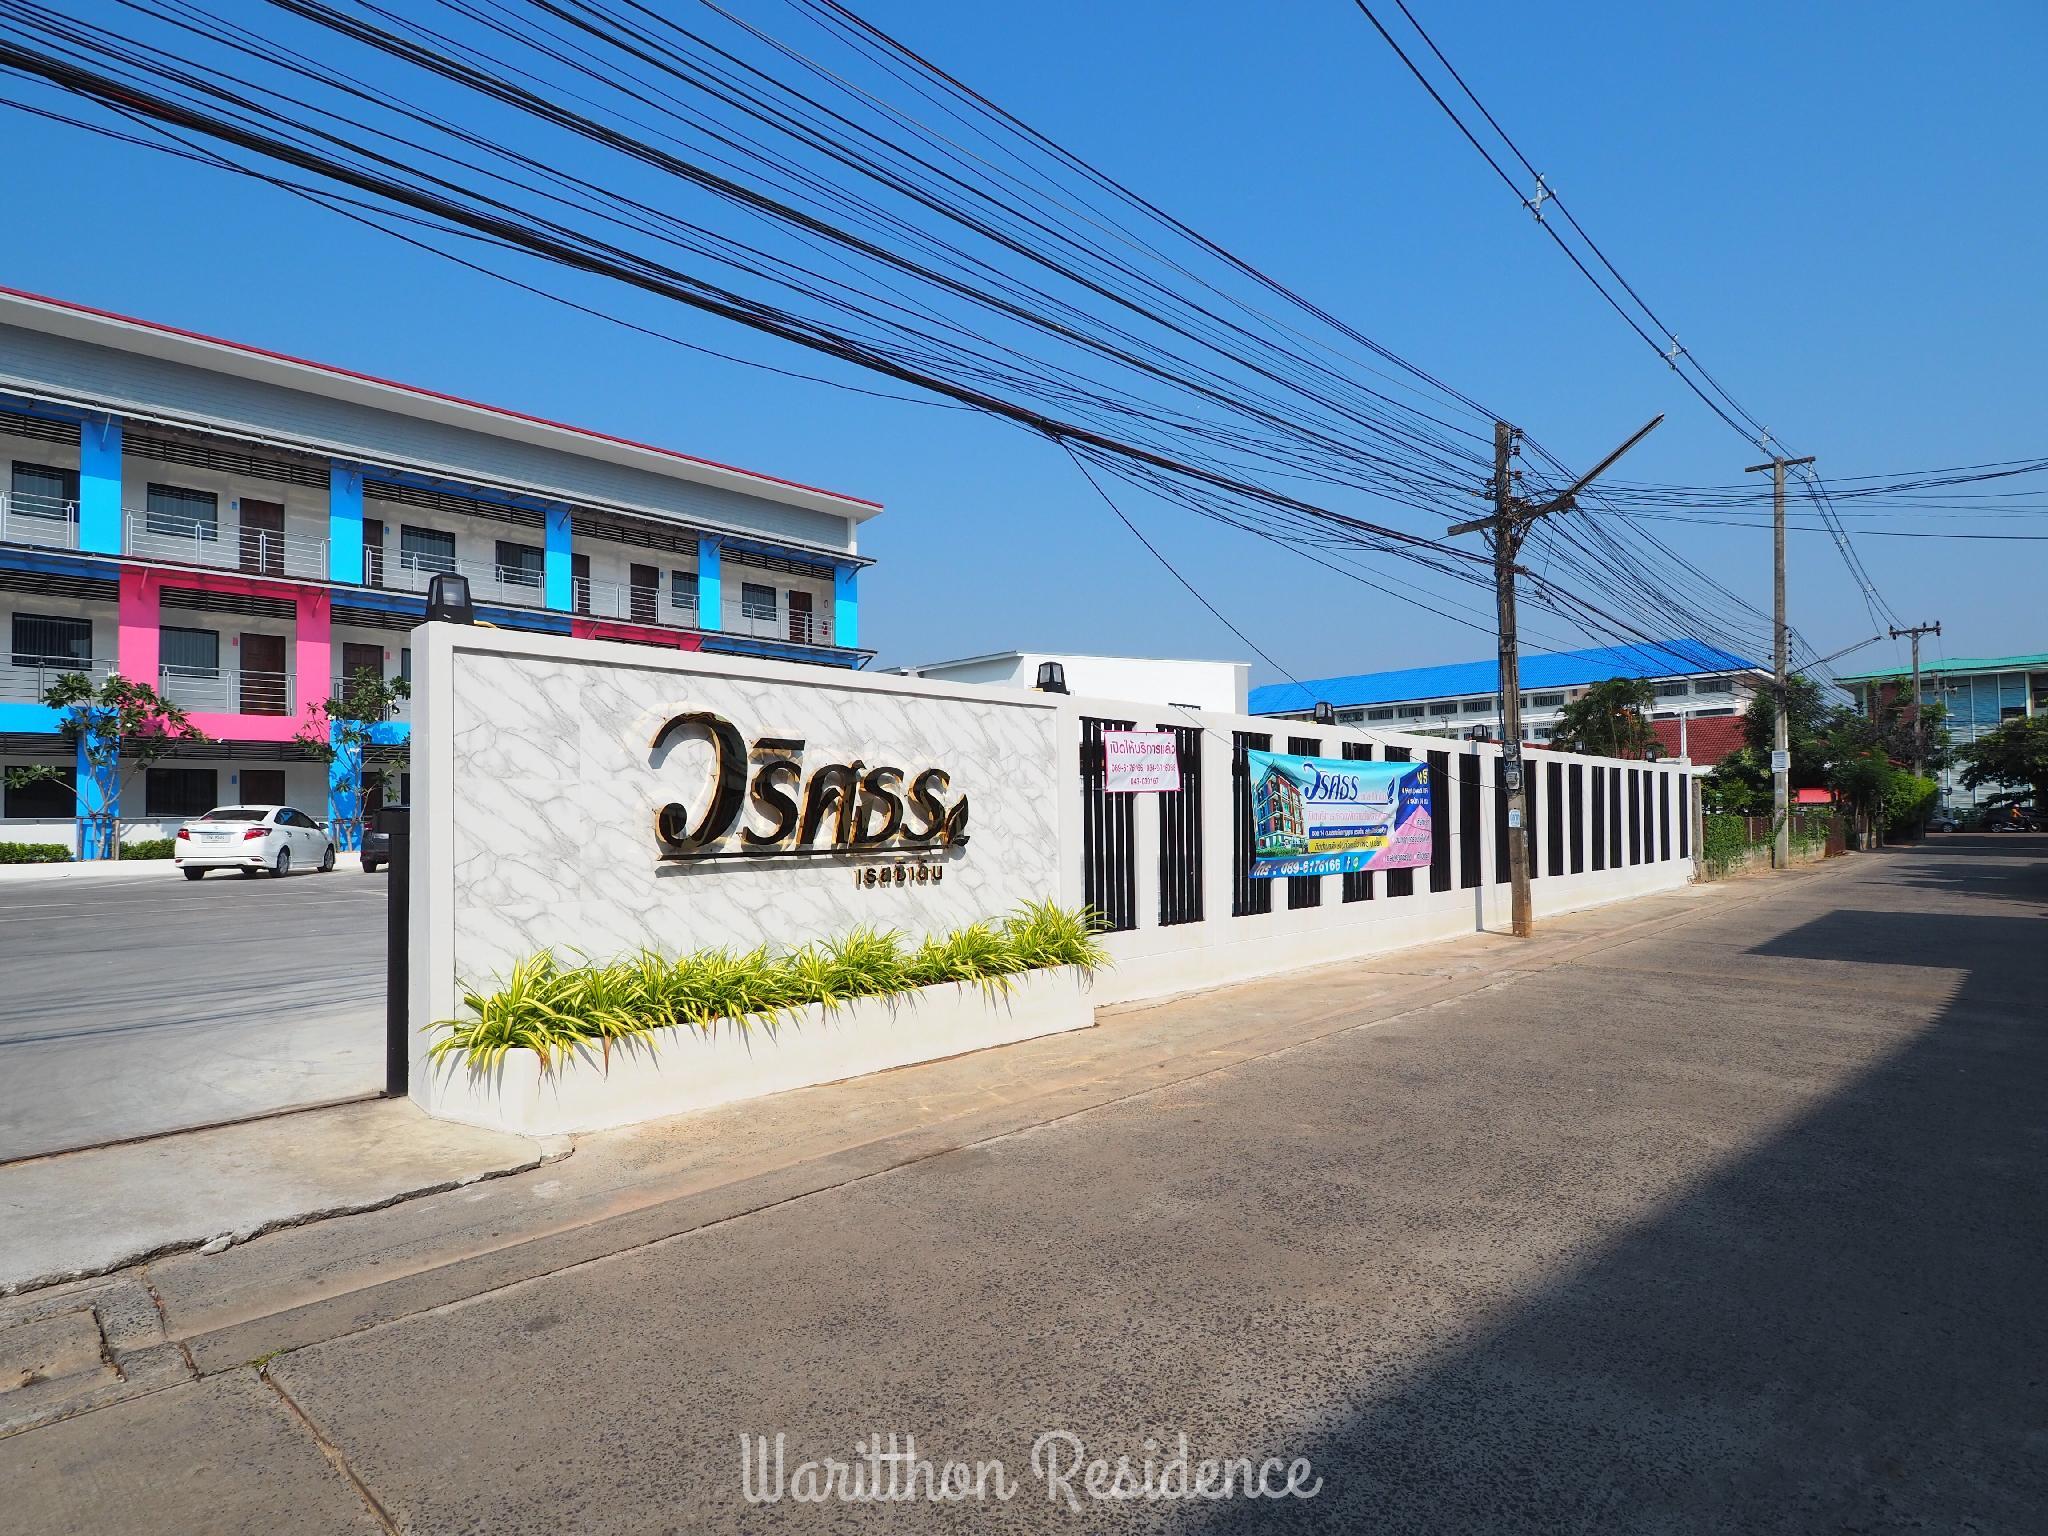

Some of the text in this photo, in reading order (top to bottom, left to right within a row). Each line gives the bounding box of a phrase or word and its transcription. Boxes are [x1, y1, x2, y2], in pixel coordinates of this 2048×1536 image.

[1110, 739, 1176, 755] เปิดให้บริการแล้ว
[1280, 859, 1341, 875] 089-6176166
